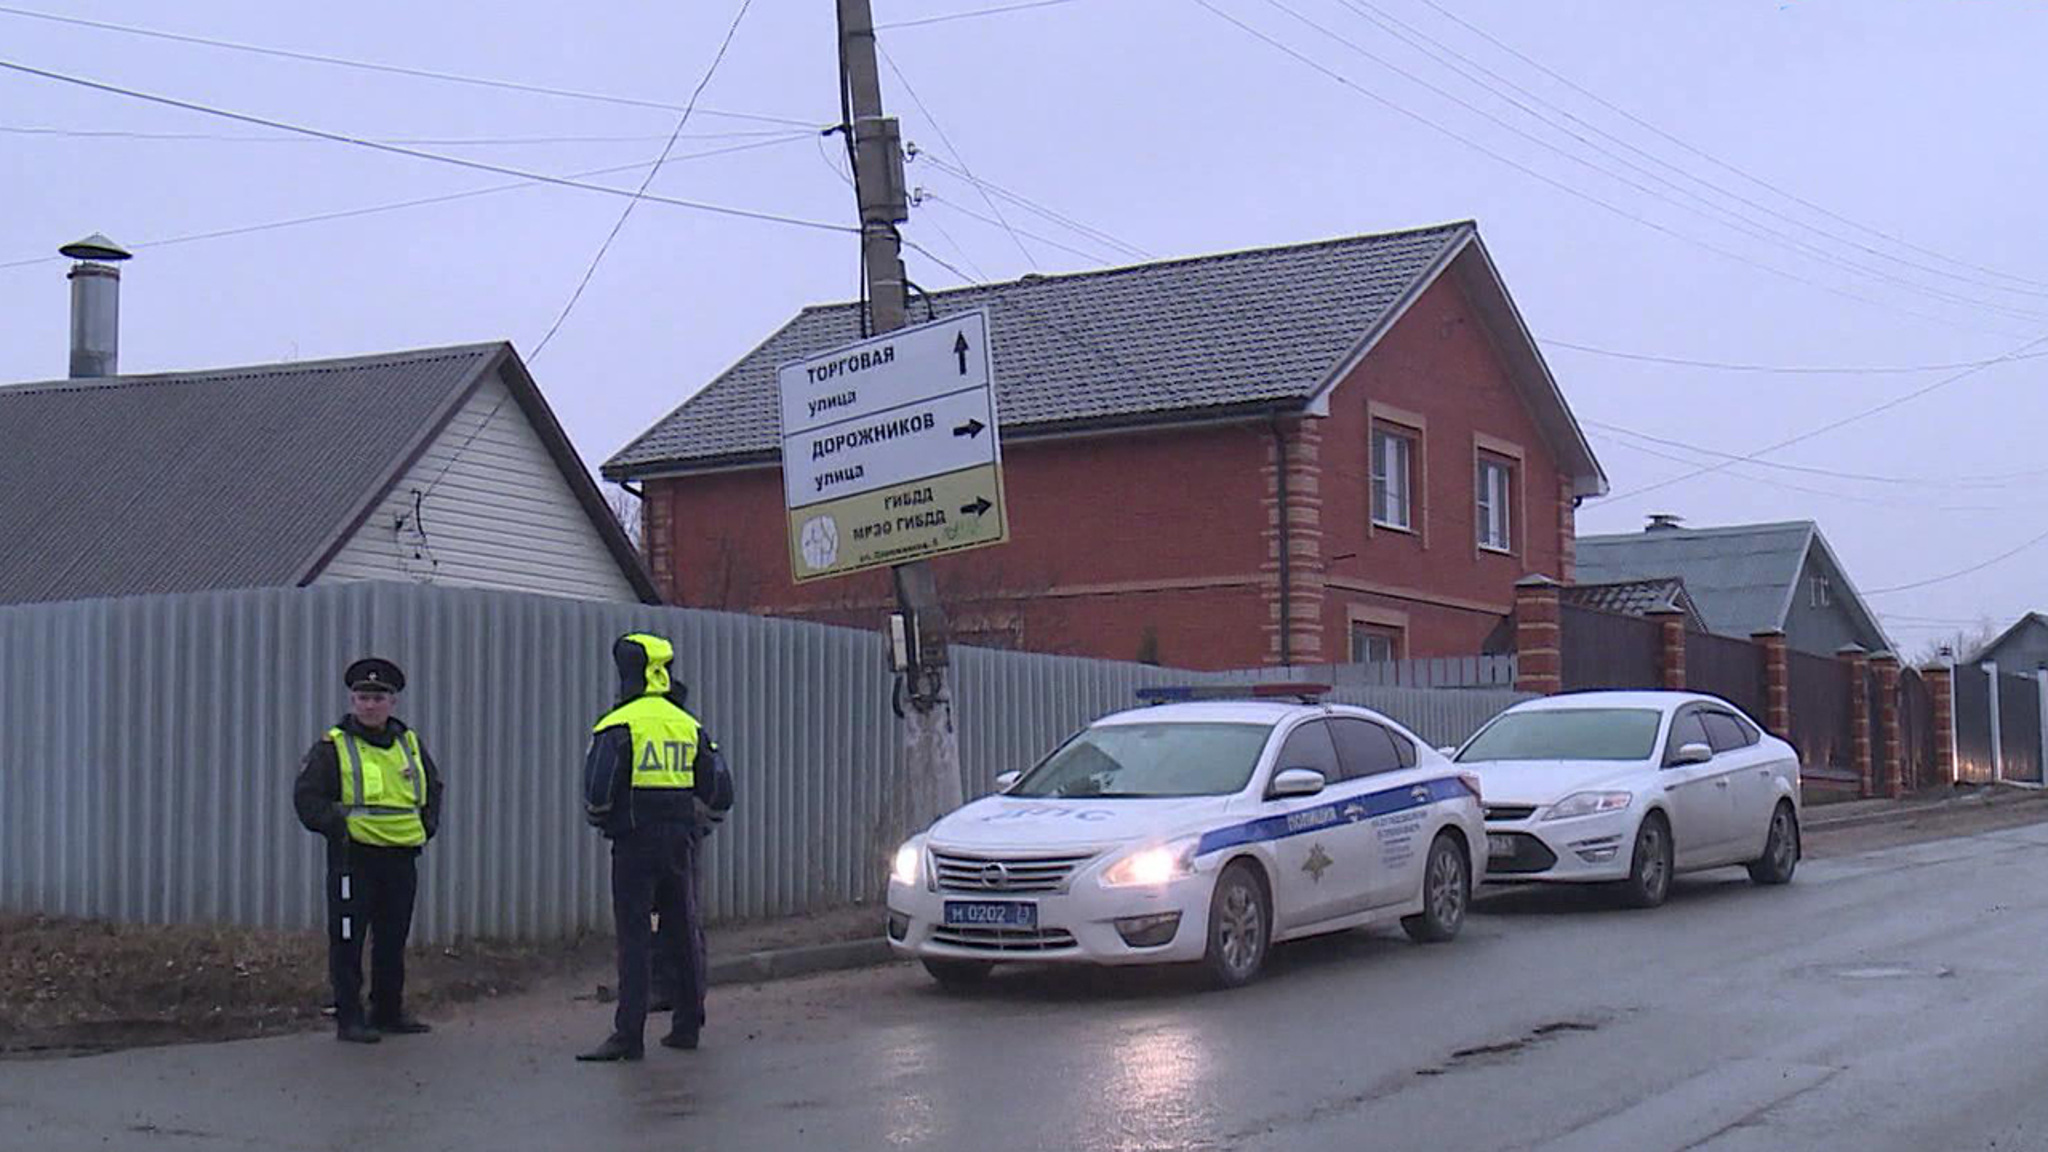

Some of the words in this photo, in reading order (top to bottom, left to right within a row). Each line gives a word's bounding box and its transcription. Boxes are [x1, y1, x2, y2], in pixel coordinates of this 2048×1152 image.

[807, 346, 895, 384] ТОРГОВАЯ
[808, 390, 857, 417] улица
[812, 412, 935, 461] ДОРОЖНИКОВ
[815, 465, 865, 492] улица
[884, 487, 934, 510] ГИБДД
[896, 510, 946, 531] ГИБДД
[637, 741, 694, 771] ДПС
